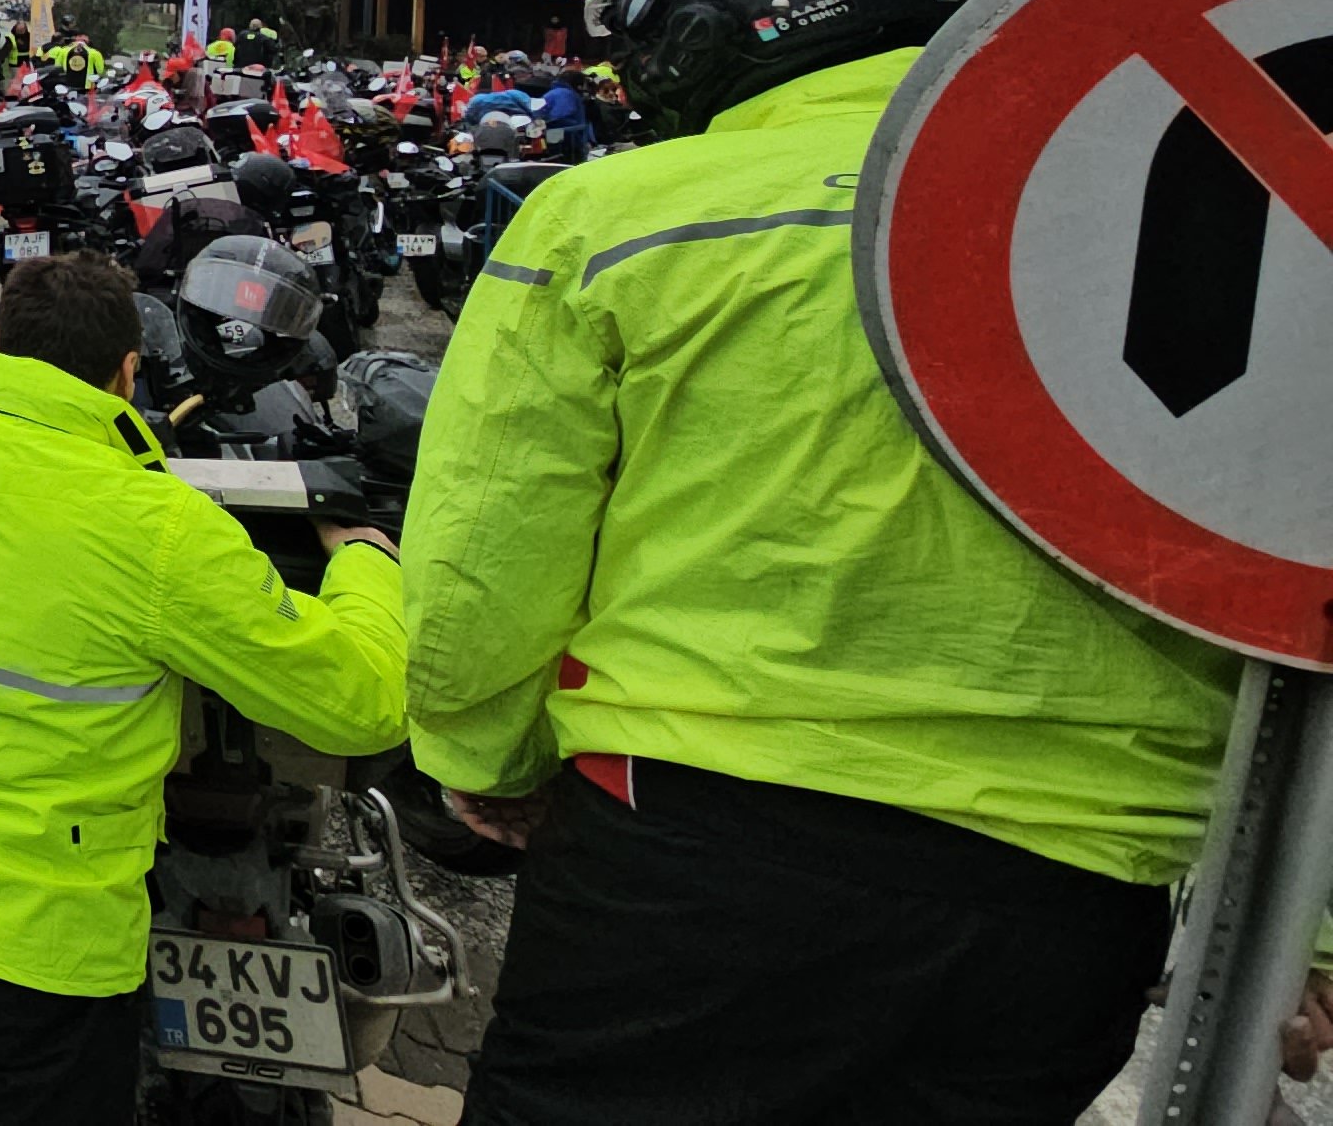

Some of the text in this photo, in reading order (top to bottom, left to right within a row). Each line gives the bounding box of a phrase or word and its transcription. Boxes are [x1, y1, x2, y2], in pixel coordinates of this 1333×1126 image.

[155, 939, 330, 1004] 34 KVJ
[164, 1028, 184, 1044] TR
[196, 996, 294, 1054] 695
